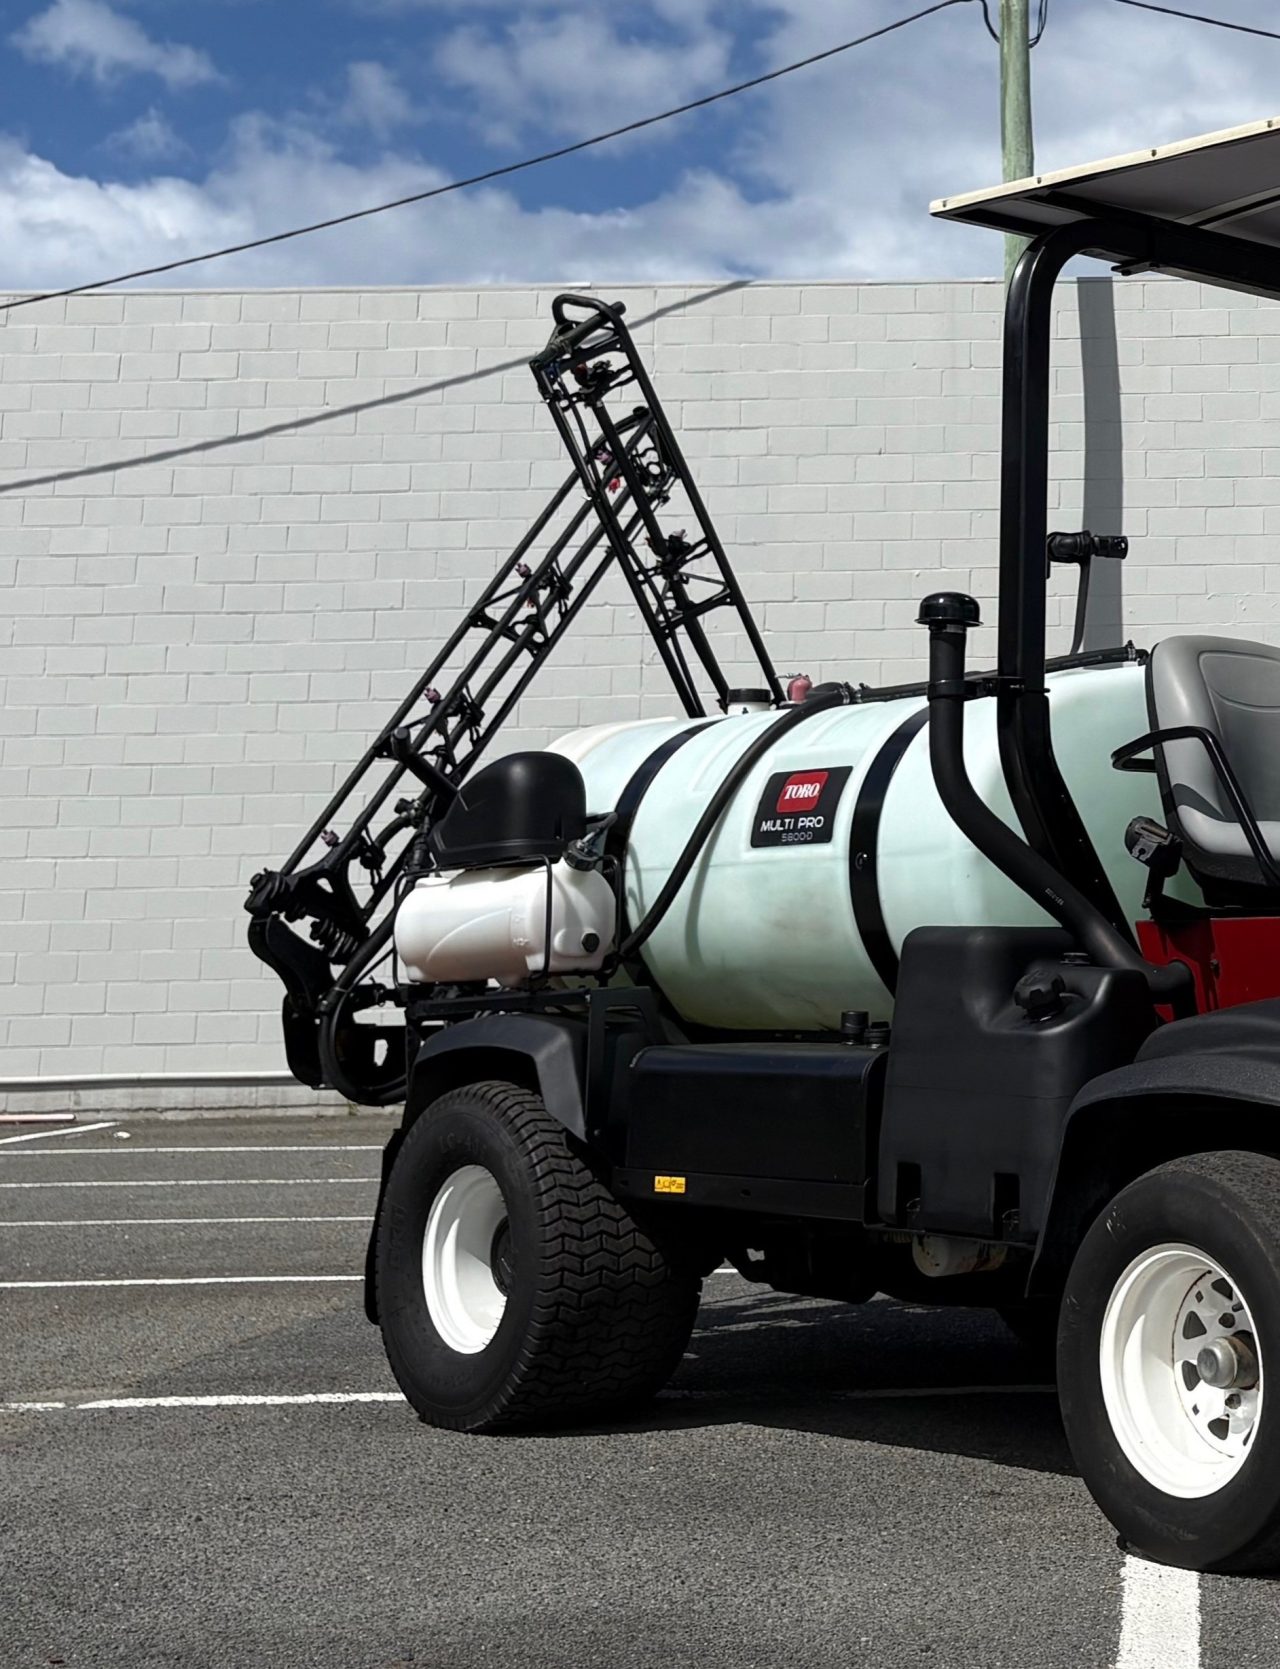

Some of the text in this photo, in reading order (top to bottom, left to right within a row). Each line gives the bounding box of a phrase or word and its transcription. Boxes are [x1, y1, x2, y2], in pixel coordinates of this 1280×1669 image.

[783, 782, 820, 800] TORO
[760, 816, 825, 832] MULTI PRO
